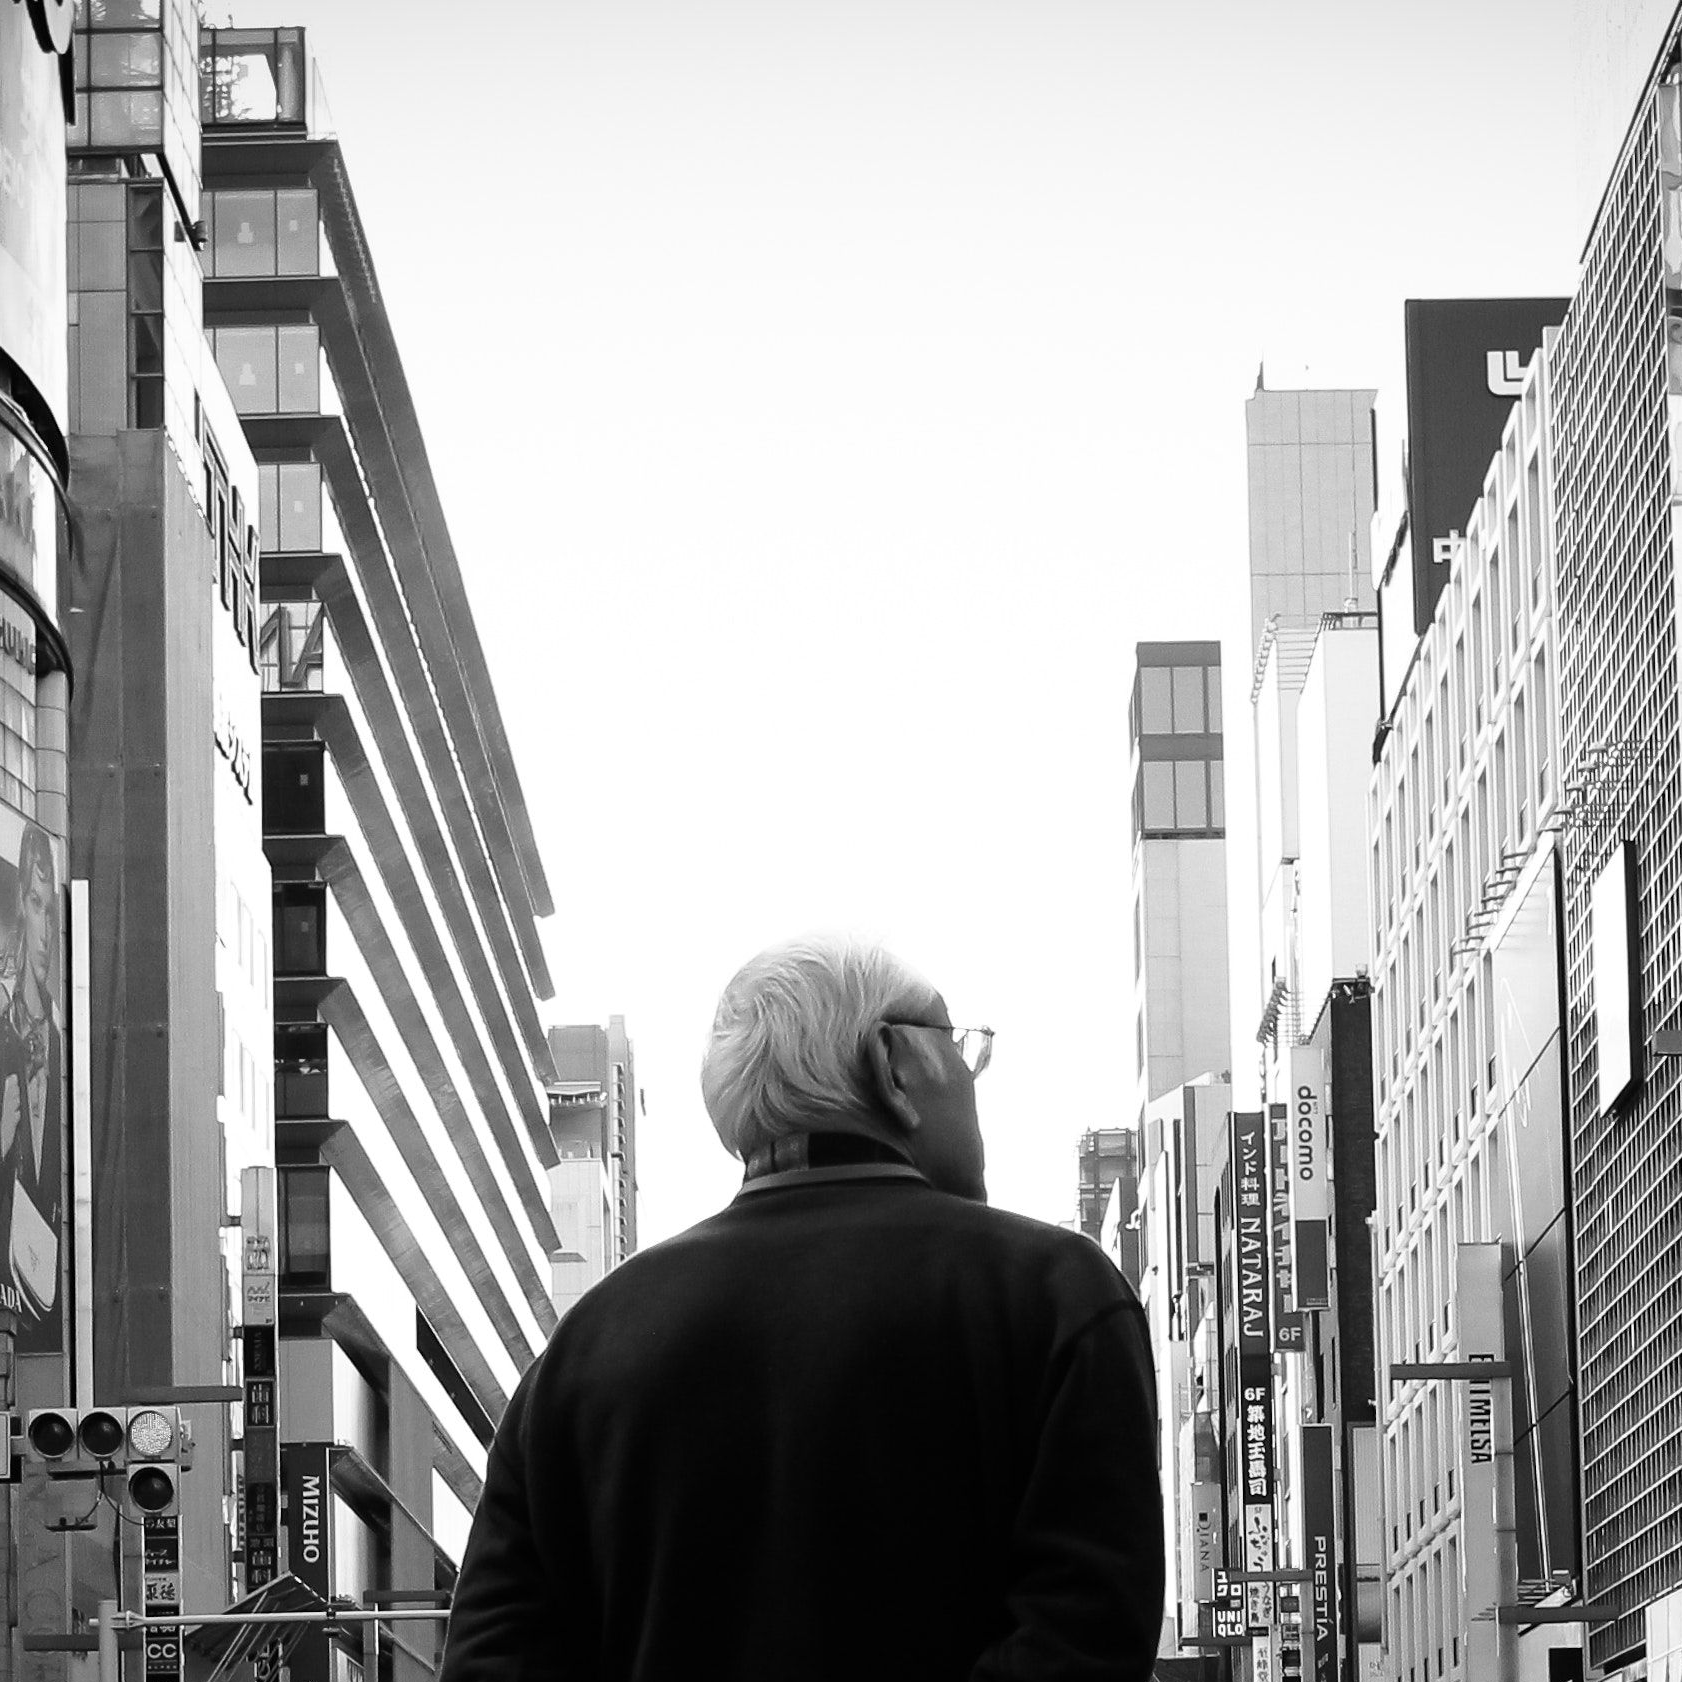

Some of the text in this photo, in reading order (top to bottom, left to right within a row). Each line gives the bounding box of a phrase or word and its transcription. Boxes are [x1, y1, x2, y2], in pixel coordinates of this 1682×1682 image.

[1297, 1084, 1317, 1181] docomo
[1239, 1130, 1265, 1339] インド料理 NATARAJ
[1278, 1326, 1302, 1342] 6F
[1244, 1387, 1266, 1401] 6F
[1246, 1404, 1268, 1497] 築地玉寿司
[302, 1474, 320, 1564] MIZUHO
[1196, 1520, 1212, 1573] DIANA
[1217, 1610, 1242, 1623] UNI
[1217, 1623, 1244, 1637] QLO
